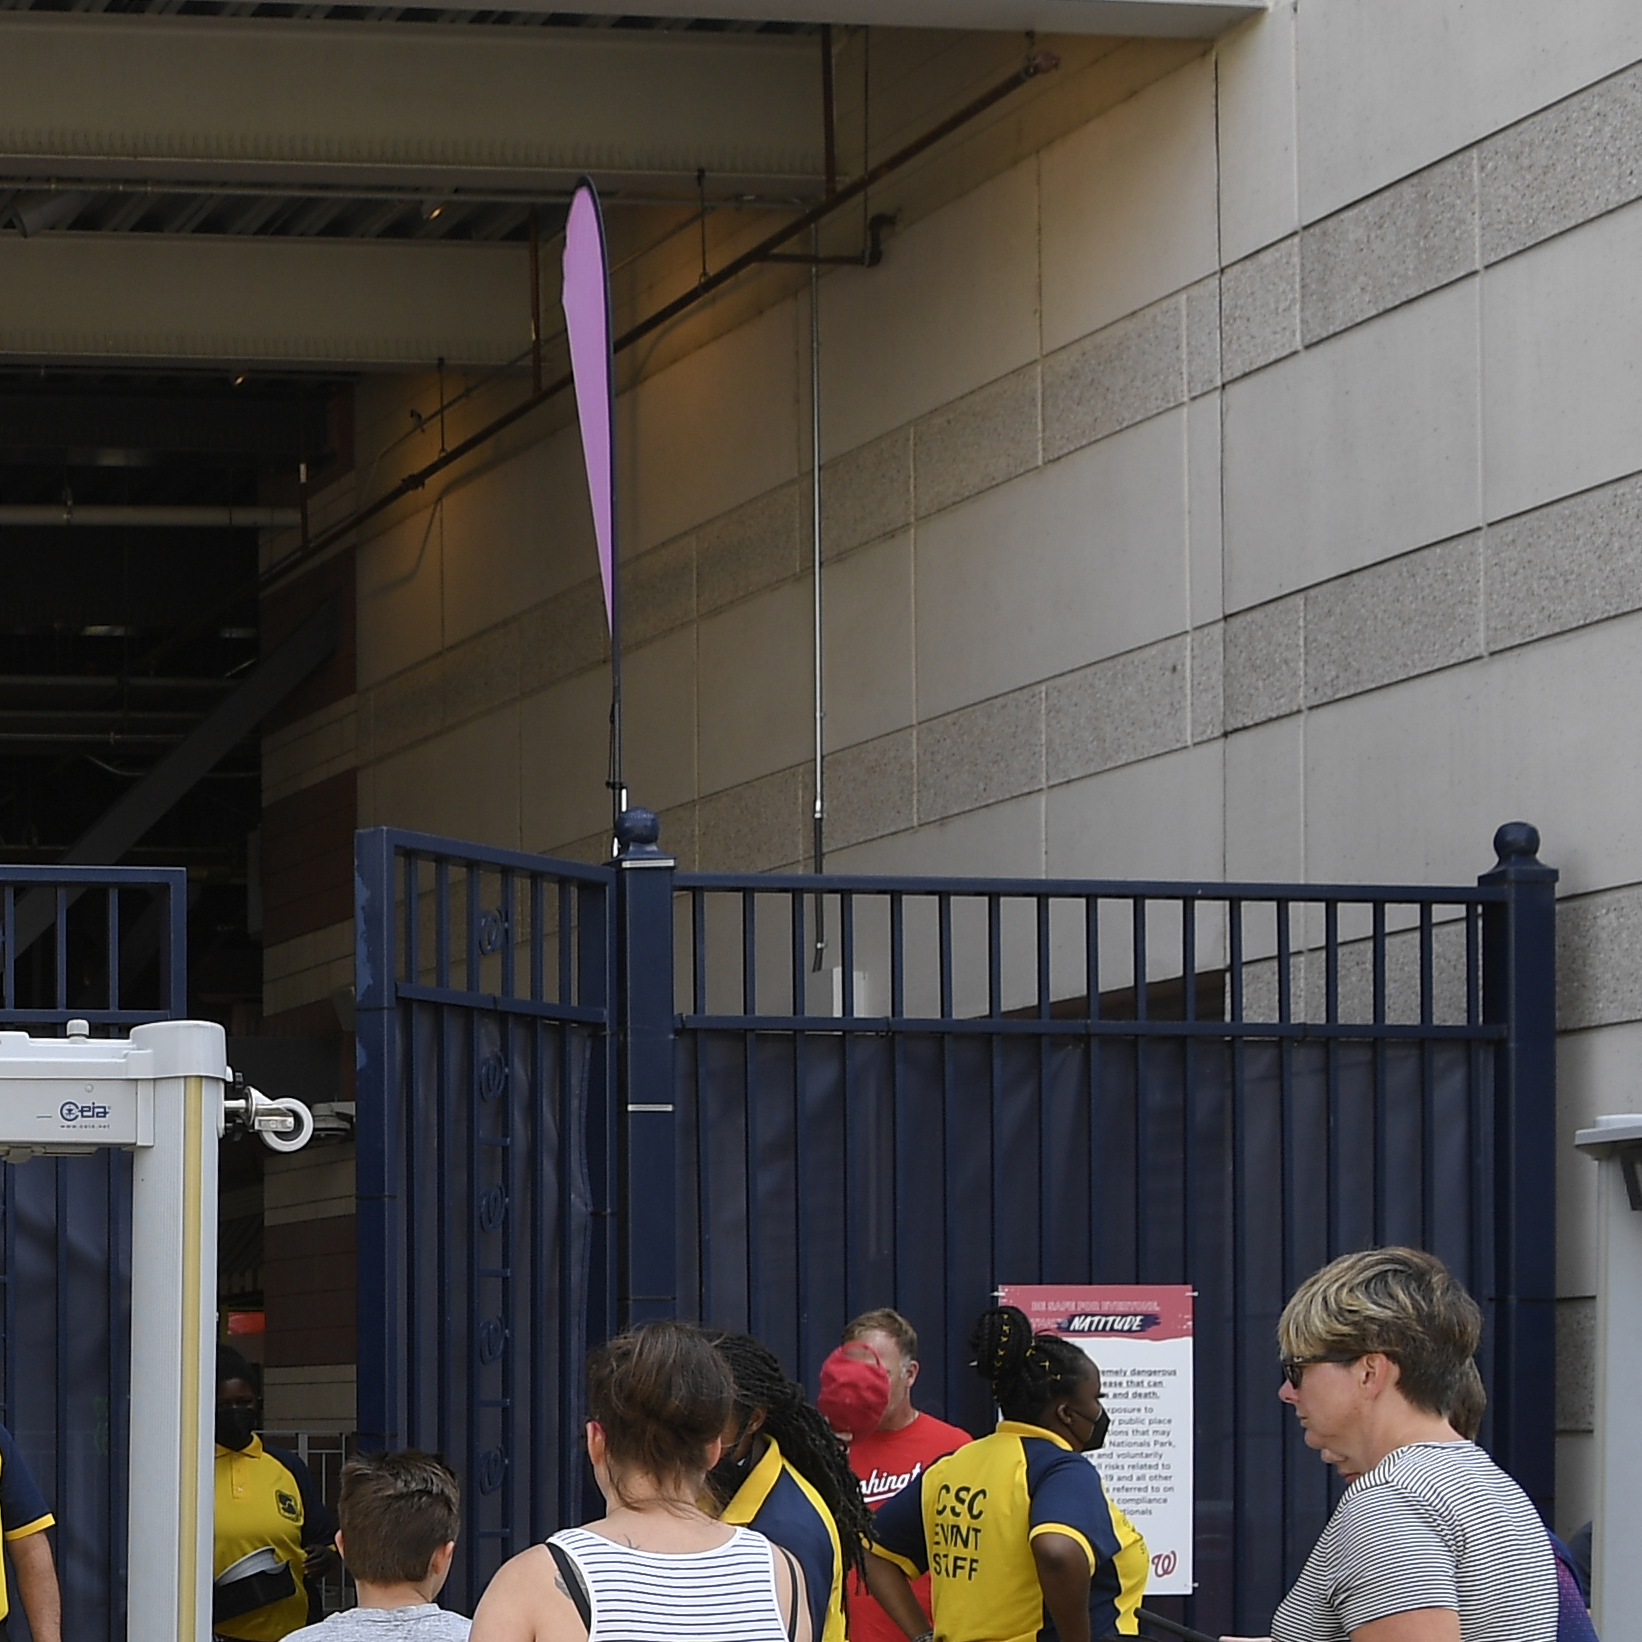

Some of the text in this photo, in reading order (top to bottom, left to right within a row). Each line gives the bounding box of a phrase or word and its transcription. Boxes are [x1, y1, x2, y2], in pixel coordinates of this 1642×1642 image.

[1070, 1315, 1144, 1332] NATITUDE
[1130, 1368, 1177, 1376] dangerous
[1126, 1379, 1144, 1387] that
[1113, 1391, 1129, 1399] and
[1132, 1391, 1160, 1399] death.
[1107, 1407, 1141, 1415] xposure
[1118, 1417, 1172, 1426] public place
[1132, 1428, 1151, 1436] that
[1153, 1430, 1171, 1438] may
[1109, 1439, 1176, 1449] Nationals Park,
[1097, 1451, 1114, 1459] and
[1116, 1451, 1163, 1460] voluntarily
[1105, 1462, 1171, 1471] risks related to
[1117, 1474, 1133, 1482] and
[1136, 1474, 1146, 1482] all
[1149, 1474, 1173, 1482] other
[1112, 1485, 1148, 1493] referred
[1151, 1485, 1160, 1493] to
[936, 1484, 987, 1520] CSC
[1117, 1497, 1168, 1505] compliance
